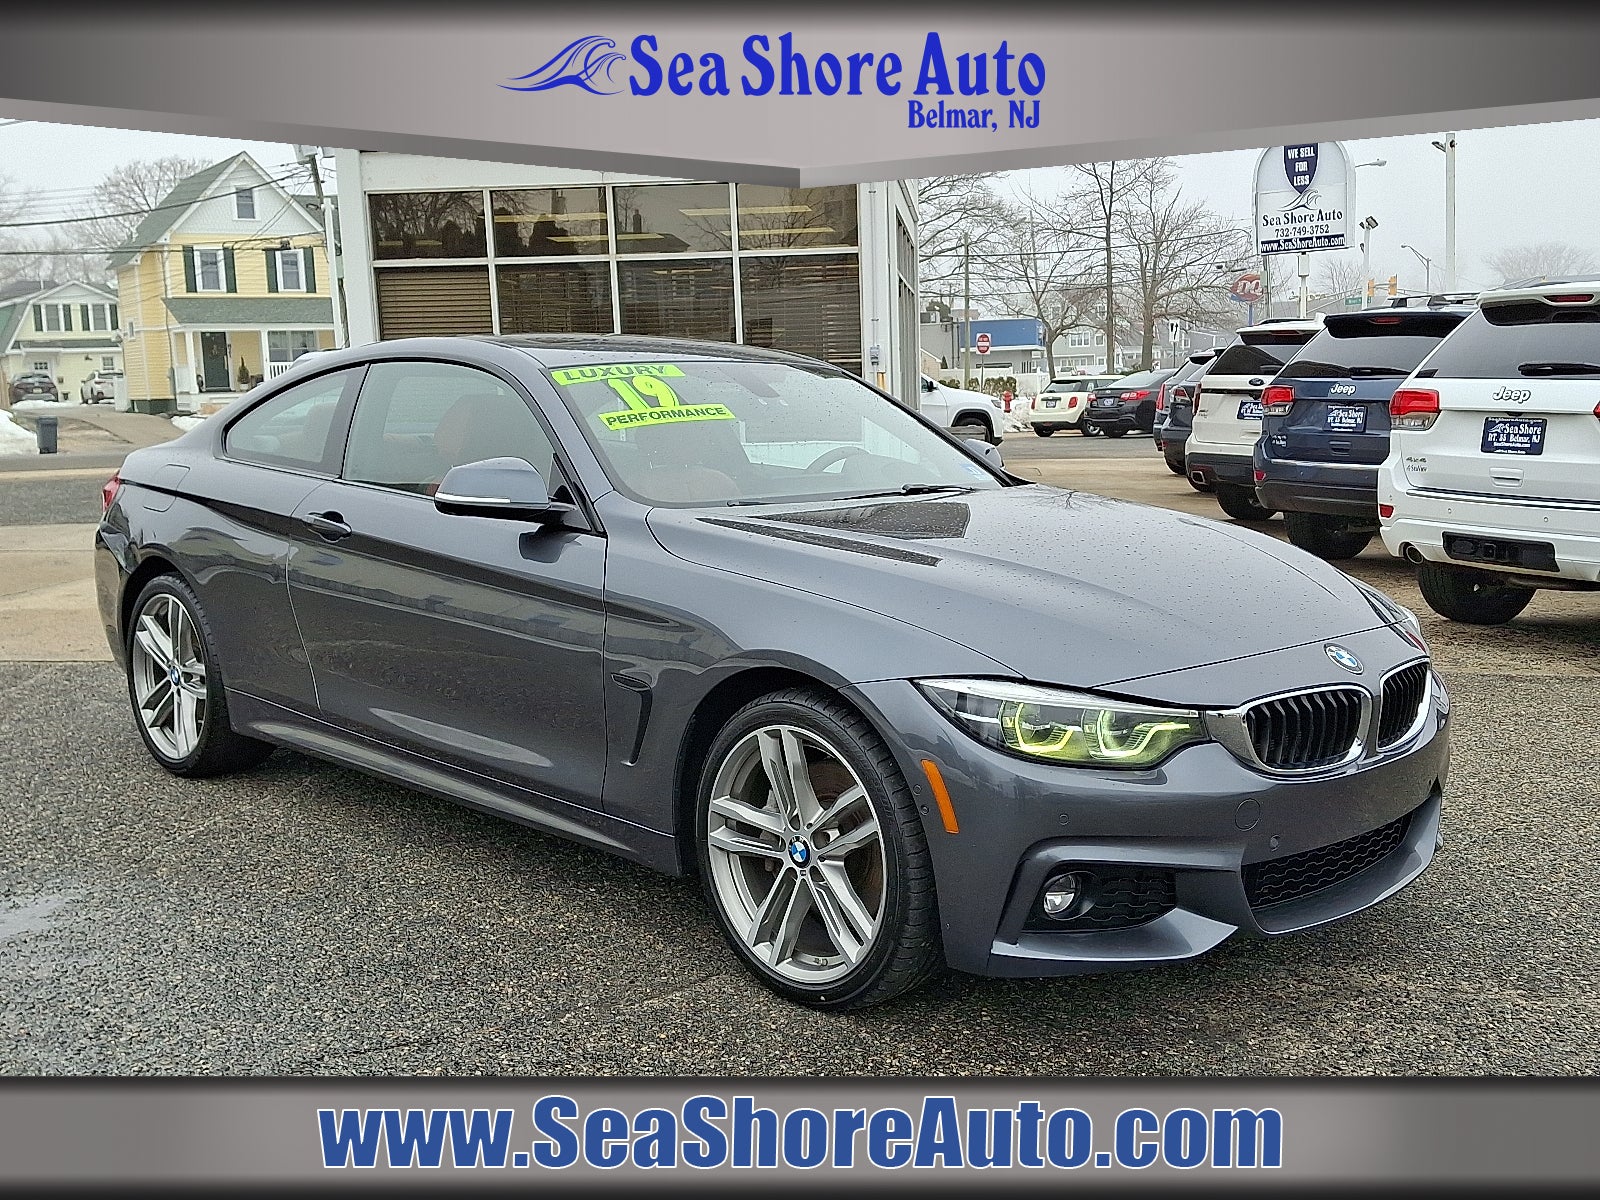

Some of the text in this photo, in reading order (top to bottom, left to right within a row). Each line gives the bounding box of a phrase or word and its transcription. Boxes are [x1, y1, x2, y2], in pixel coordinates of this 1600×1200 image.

[1287, 147, 1315, 159] WE SELL
[1295, 161, 1308, 172] FOR
[1293, 175, 1310, 186] LESS
[1262, 208, 1343, 227] Sea Shore Auto
[1275, 224, 1330, 238] 732-749-3752
[1261, 237, 1345, 251] www.SeaShoreAuto.com
[563, 366, 666, 380] LUXURY
[607, 375, 680, 411] 19
[1330, 383, 1356, 396] Jeep
[1492, 385, 1532, 404] Jeep
[606, 407, 727, 425] PERFORMANCE
[1504, 423, 1542, 435] Sea Shore
